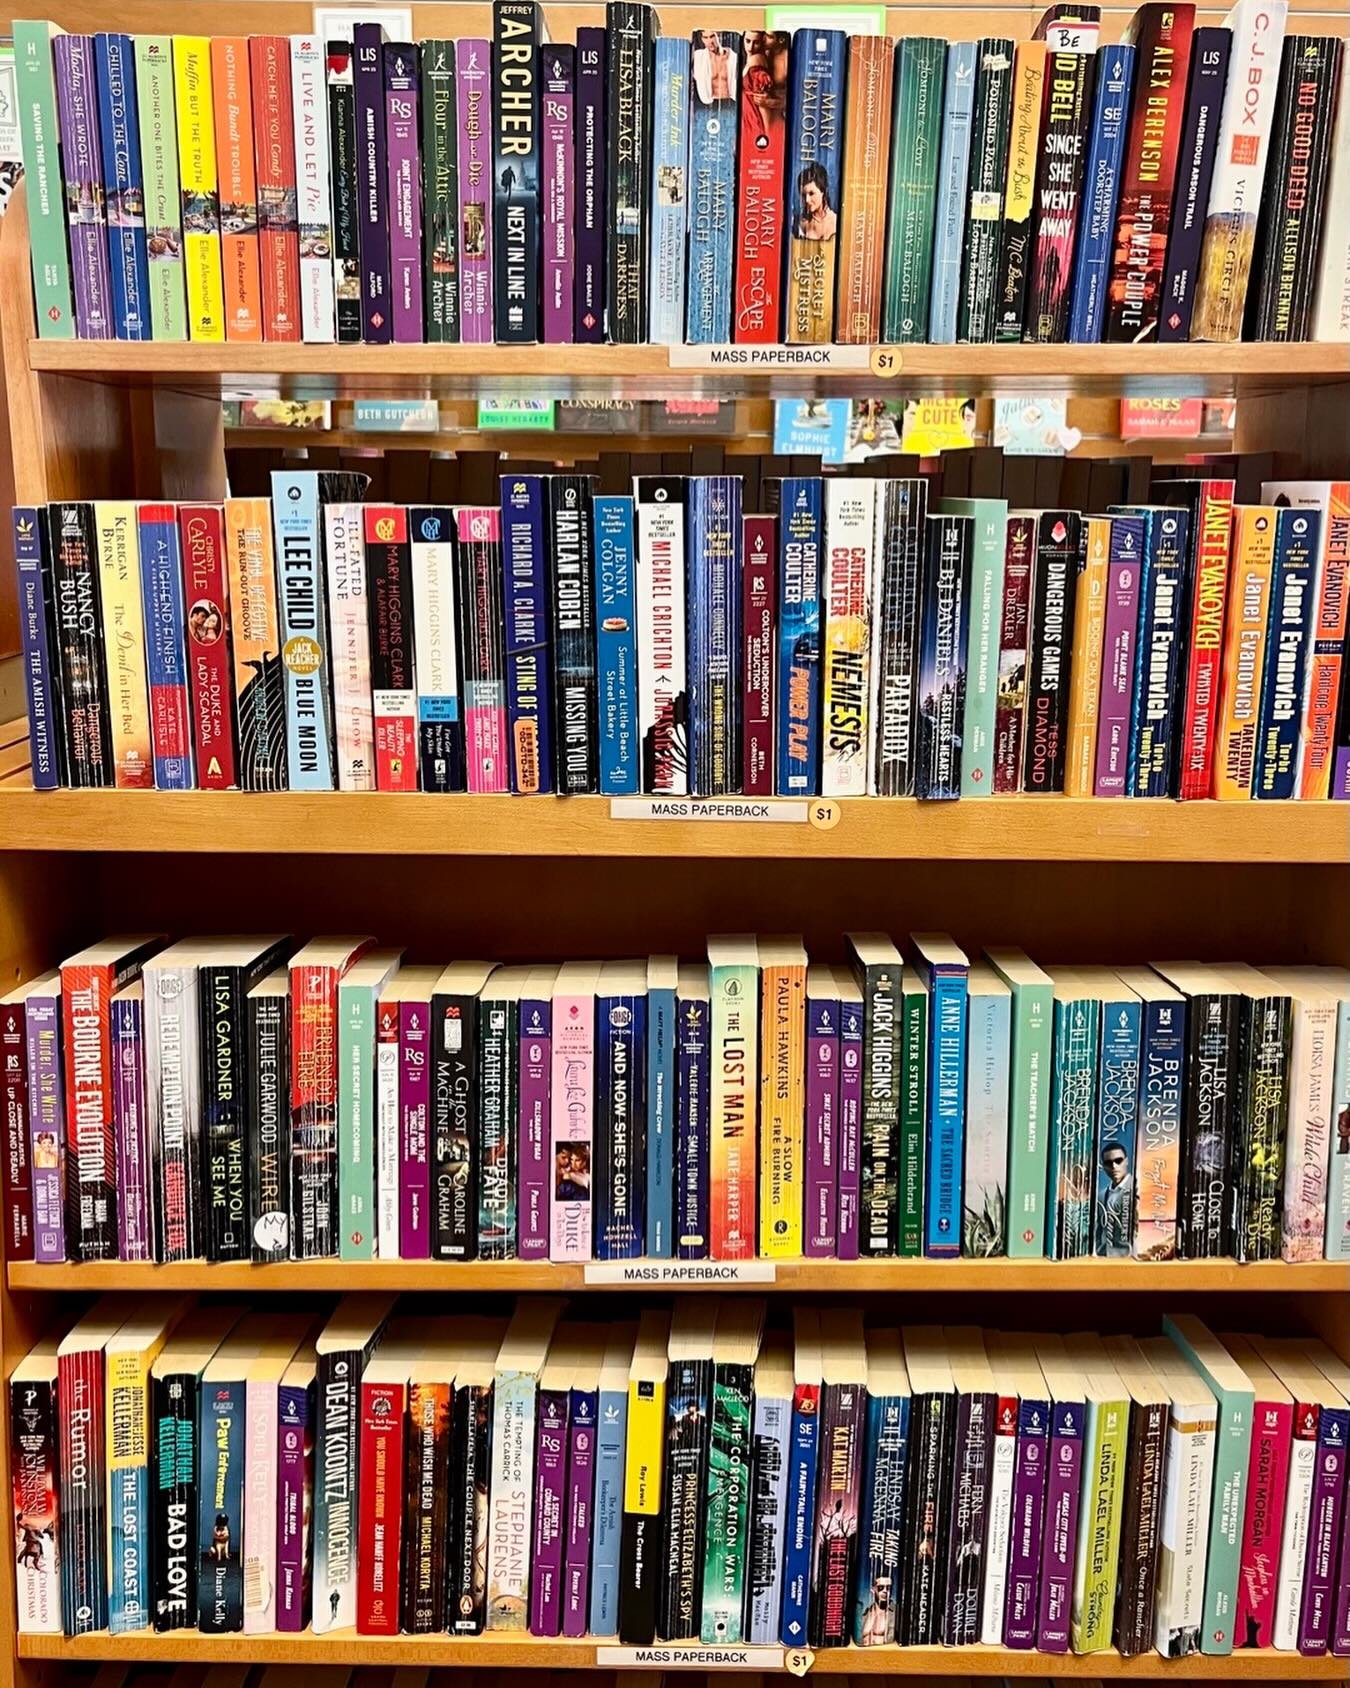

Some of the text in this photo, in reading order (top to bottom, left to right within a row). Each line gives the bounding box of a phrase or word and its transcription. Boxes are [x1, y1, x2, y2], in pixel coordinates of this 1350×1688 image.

[500, 6, 532, 14] JEFFREY
[70, 45, 88, 166] Mocha, SHE WROTE
[109, 45, 128, 181] CHILLED TO THE Cone
[224, 45, 242, 196] NOTHING Bundt TROUBLE
[500, 18, 532, 156] ARCHER
[1139, 46, 1174, 182] ALEX BERENSON
[32, 104, 49, 215] SAVING THE RANCHER
[302, 73, 320, 212] LIVE AND LET Pie
[366, 108, 378, 222] AMISH COUNTRY KILLER
[1046, 134, 1082, 155] SINCE
[1048, 162, 1076, 182] SHE
[1286, 82, 1317, 210] NO GOOD DEED
[744, 185, 760, 259] BALOGH
[761, 198, 775, 249] MARY
[1039, 218, 1072, 238] AWAY
[1040, 190, 1077, 211] WENT
[508, 206, 525, 299] NEXT IN LINE
[1275, 219, 1300, 332] ALLISON BRENNAN
[711, 351, 831, 362] MASS PAPERBACK
[878, 355, 894, 368] $1
[791, 431, 832, 443] SOPHIE
[922, 409, 958, 426] CUTE
[1128, 399, 1182, 411] ROSES
[283, 536, 315, 630] LEE CHILD
[333, 516, 348, 601] FORTUNE
[348, 521, 362, 596] ILL-FATED
[556, 510, 581, 630] HARLAN COBEN
[601, 539, 614, 604] COLGAN
[614, 546, 626, 596] JENNY
[784, 543, 802, 604] COULTER
[802, 542, 818, 602] CATHERINE
[26, 582, 38, 640] Diane Burke
[60, 580, 78, 629] BUSH
[76, 571, 95, 637] NANCY
[652, 541, 672, 670] MICHAEL CRICHTON
[1040, 563, 1066, 691] DANGEROUS GAMES
[1272, 573, 1308, 721] Janet Evanovich
[30, 650, 49, 773] THE AMISH WITNESS
[197, 656, 212, 746] LADY SCANDAL
[295, 679, 318, 773] BLUE MOON
[565, 687, 587, 772] MISSING YOU
[605, 671, 617, 739] Street Bakery
[618, 646, 629, 762] Summer at Little Beach
[830, 650, 863, 752] NEMESIS
[1226, 730, 1241, 781] TWENTY
[1238, 722, 1255, 788] TAKEDOWN
[652, 804, 769, 816] MASS PAPERBACK
[816, 808, 831, 820] $1
[215, 976, 232, 1100] LISA GARDNER
[723, 1012, 744, 1138] THE LOST MAN
[777, 977, 789, 1099] PAULA HAWKINS
[871, 993, 892, 1099] JACK HIGGINS
[908, 1008, 919, 1115] WINTER STROLL
[939, 997, 959, 1116] ANNE HILLERMAN
[7, 1087, 15, 1099] UP
[8, 1101, 16, 1128] CLOSE
[71, 988, 105, 1184] THE BOURNE EVOLUTION
[352, 1045, 360, 1163] HER SECRET HOMECOMING
[614, 1041, 626, 1216] AND NOW SHE'S GONE
[1145, 1053, 1162, 1150] JACKSON
[1162, 1060, 1178, 1146] BRENDA
[10, 1152, 20, 1184] DEADLY
[624, 1267, 739, 1279] MASS PAPERBACK
[324, 1382, 348, 1502] DEAN KOONTZ
[123, 1472, 139, 1596] THE LOST COAST
[462, 1463, 474, 1590] THE COUPLE NEXT DOOR
[724, 1415, 742, 1598] THE CORPORATION WARS:
[1092, 1443, 1112, 1574] LINDA LAEL MILLER
[1252, 1439, 1271, 1546] SARAH MORGAN
[167, 1504, 186, 1612] BAD LOVE
[327, 1502, 349, 1586] INNOCENCE
[419, 1516, 432, 1590] MICHAEL KORYTA
[634, 1521, 645, 1589] The Cross Bearer
[212, 1567, 226, 1625] Diane Kelly
[635, 1651, 748, 1663] MASS PAPERBACK
[792, 1656, 807, 1667] $1
